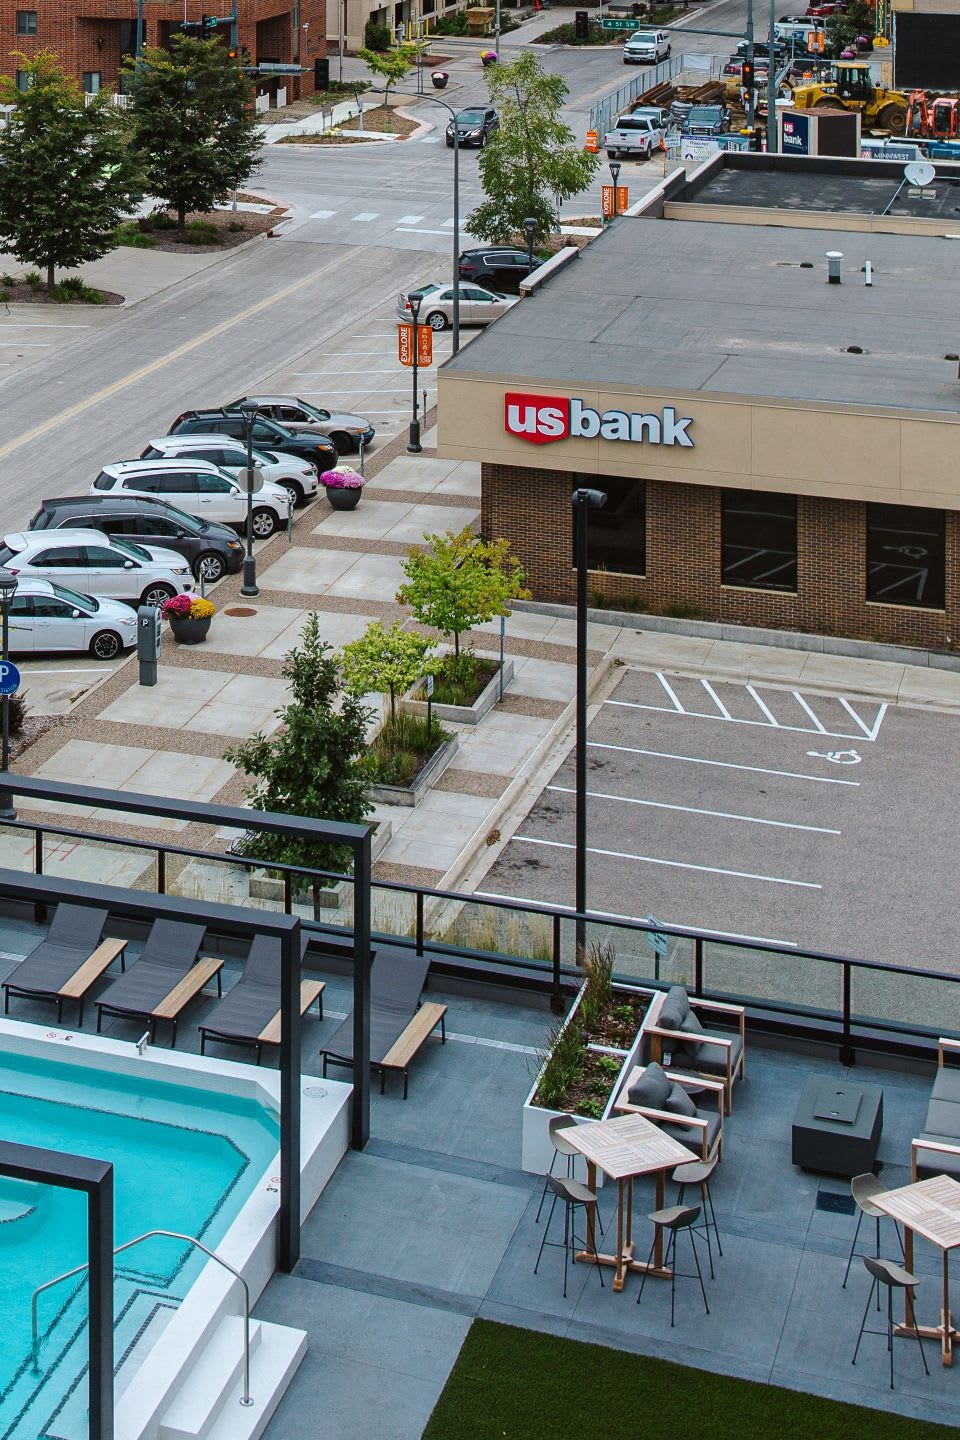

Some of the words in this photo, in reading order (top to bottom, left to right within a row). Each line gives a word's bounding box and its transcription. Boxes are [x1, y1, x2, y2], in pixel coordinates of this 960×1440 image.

[783, 122, 794, 133] us
[783, 133, 803, 146] bank
[873, 152, 910, 160] MINNWEST
[400, 327, 408, 363] EXPLORE
[507, 404, 565, 436] us
[570, 398, 694, 447] bank
[142, 618, 149, 627] P
[0, 664, 10, 683] P
